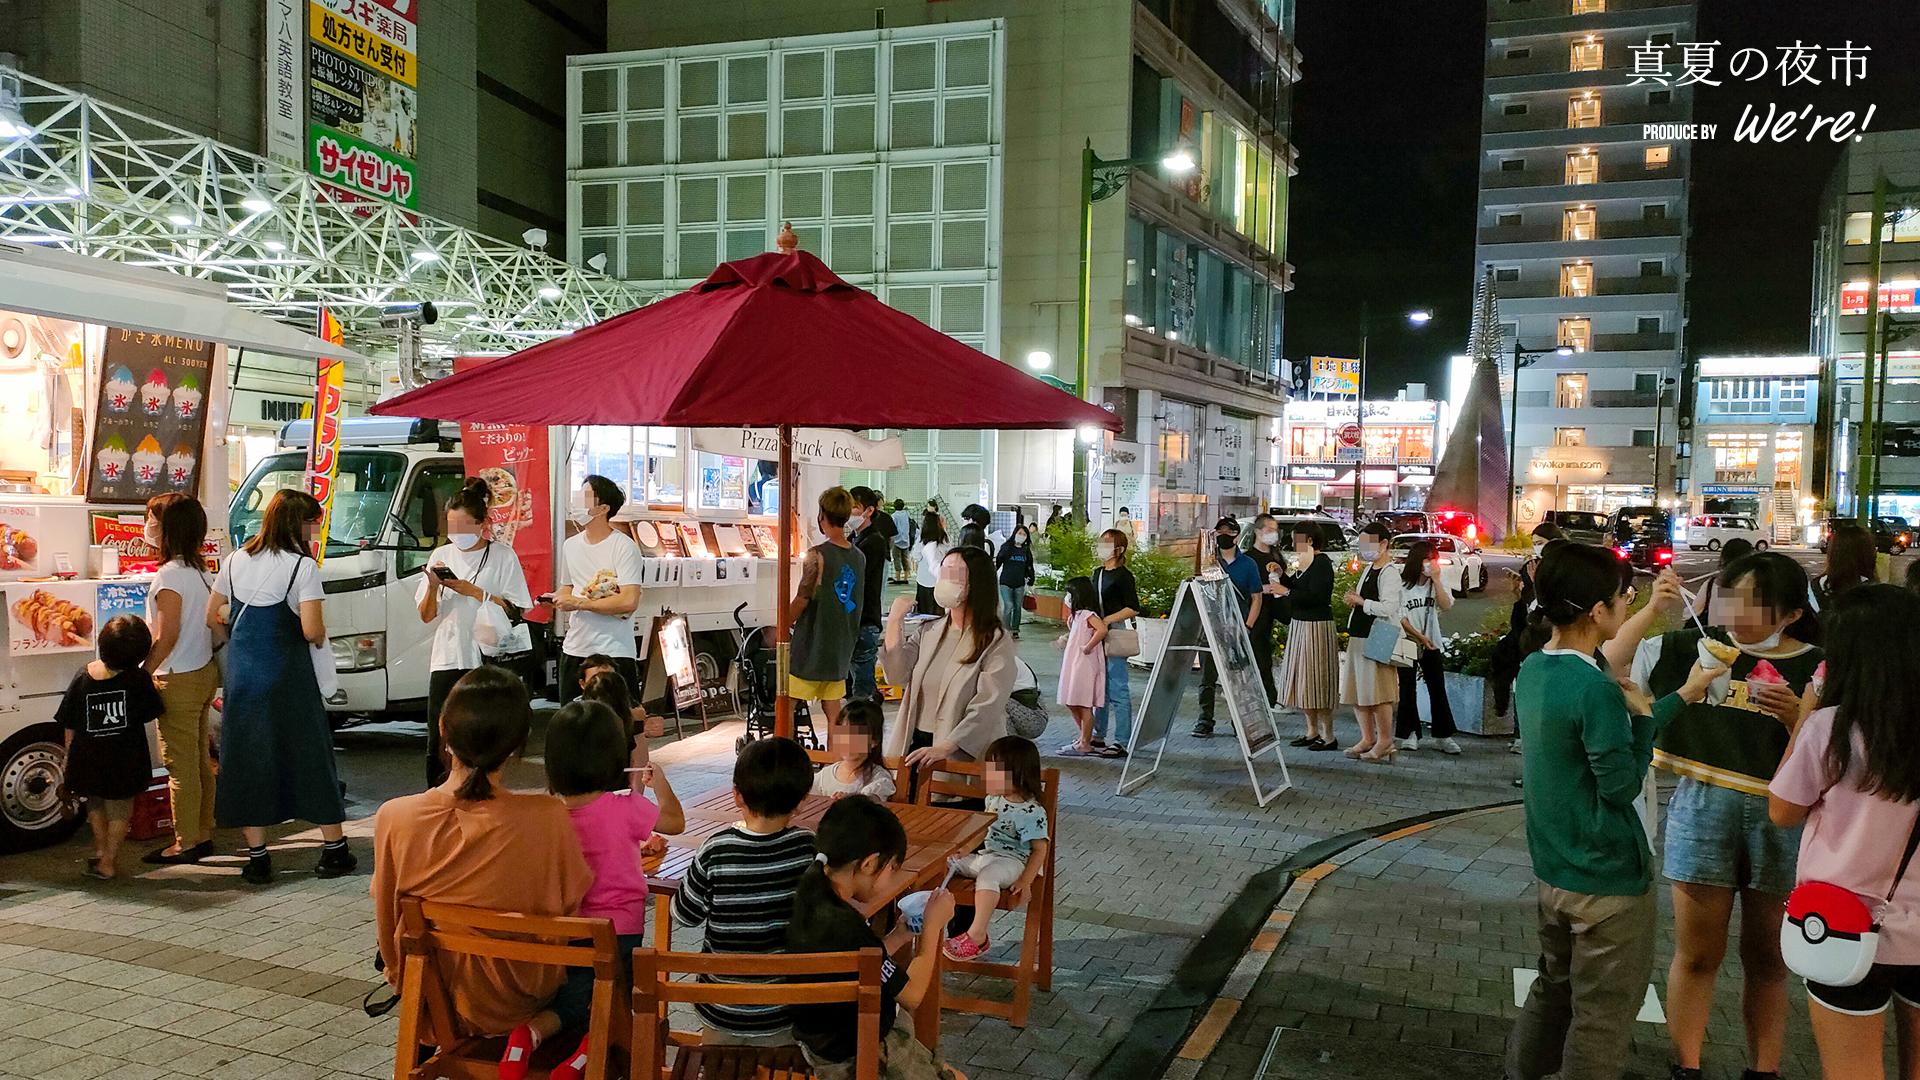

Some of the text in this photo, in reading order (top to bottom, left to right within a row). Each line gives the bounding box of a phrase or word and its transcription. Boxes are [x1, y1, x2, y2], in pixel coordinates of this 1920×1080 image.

[322, 13, 407, 77] 処方せん受付
[311, 46, 386, 91] PHOTO STUDIO
[317, 138, 413, 204] サイゼリヤ
[163, 355, 177, 365] ALL
[741, 429, 778, 451] Pizza
[104, 522, 122, 532] ICE
